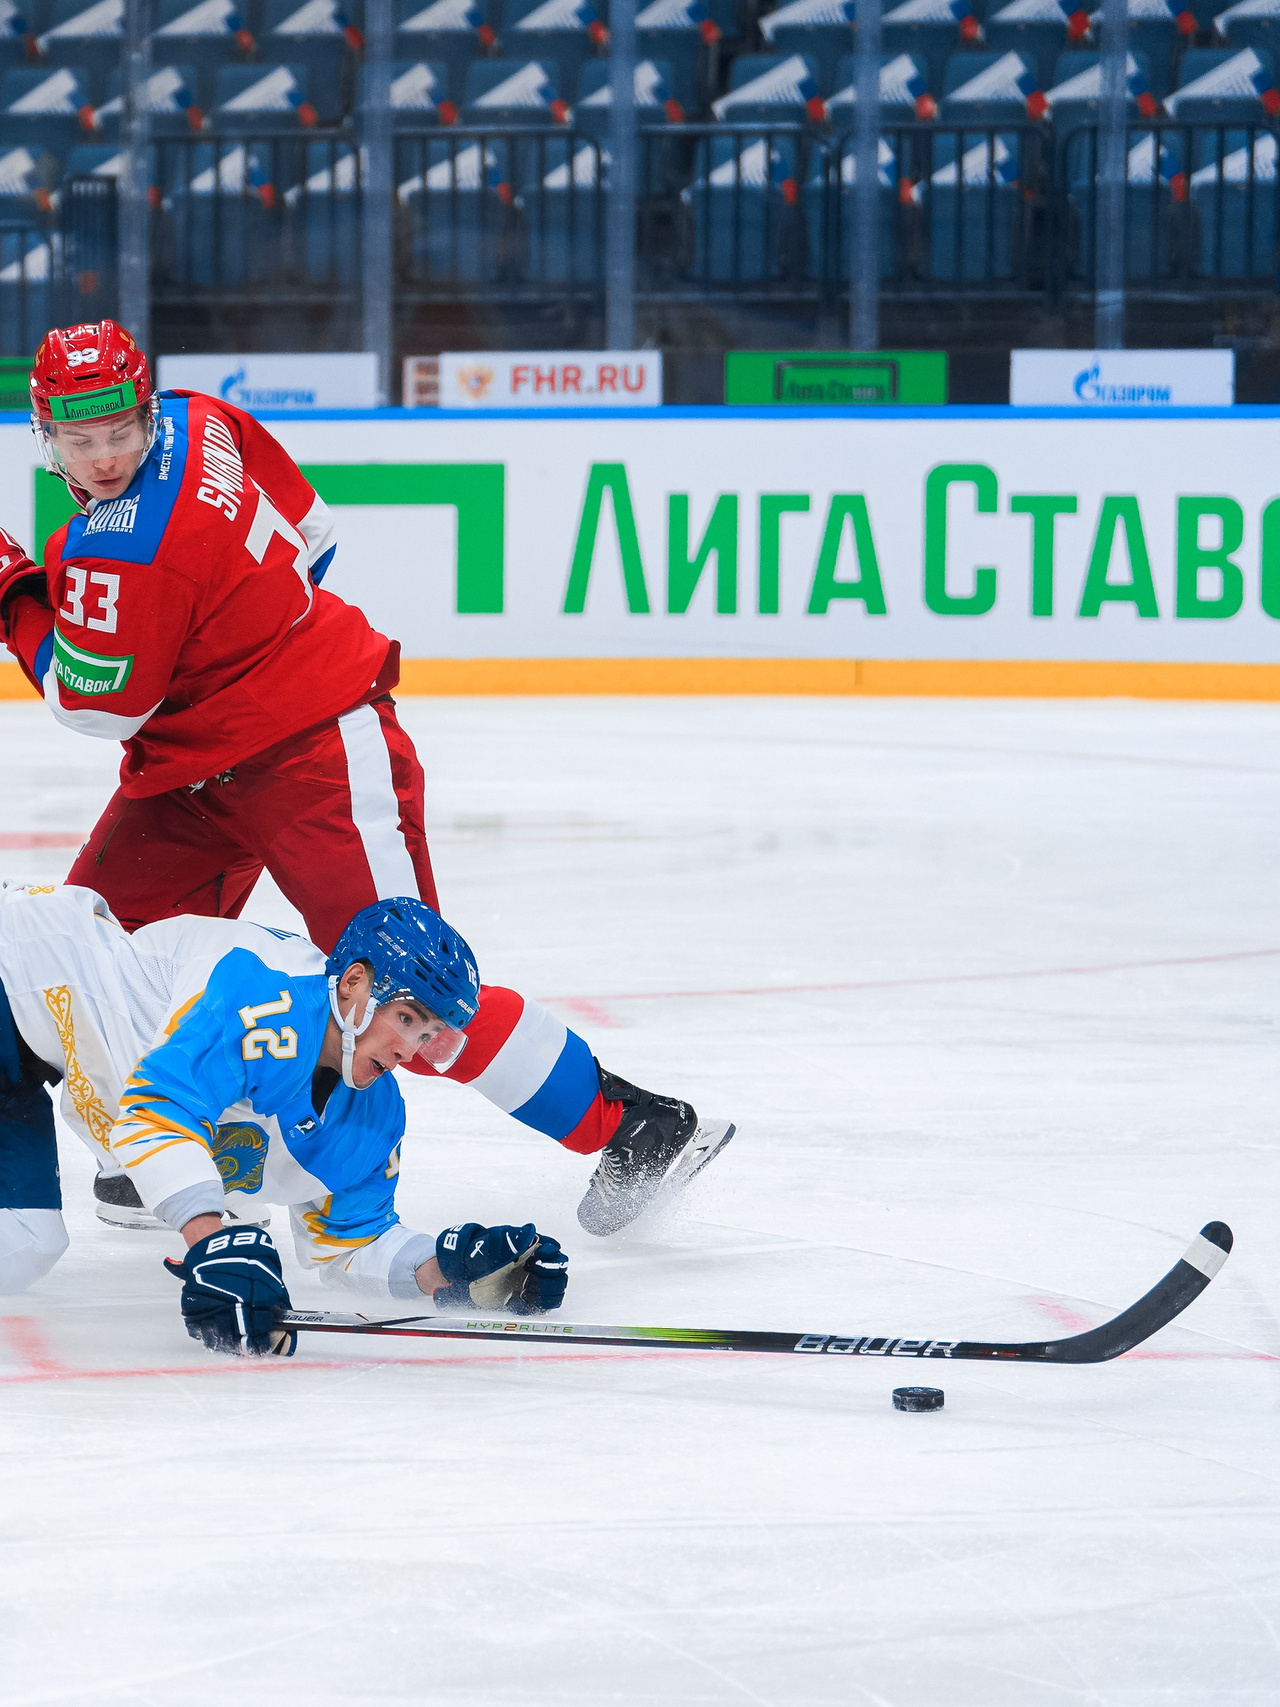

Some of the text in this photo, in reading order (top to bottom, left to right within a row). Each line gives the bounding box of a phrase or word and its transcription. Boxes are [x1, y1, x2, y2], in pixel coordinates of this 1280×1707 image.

[511, 364, 646, 394] FHR.RU
[196, 414, 245, 522] SMIRNOV
[58, 566, 121, 634] 33
[237, 990, 299, 1061] 12
[205, 1231, 276, 1256] BAU
[466, 1322, 574, 1334] HYP2RLITE
[793, 1334, 961, 1358] BAUER
